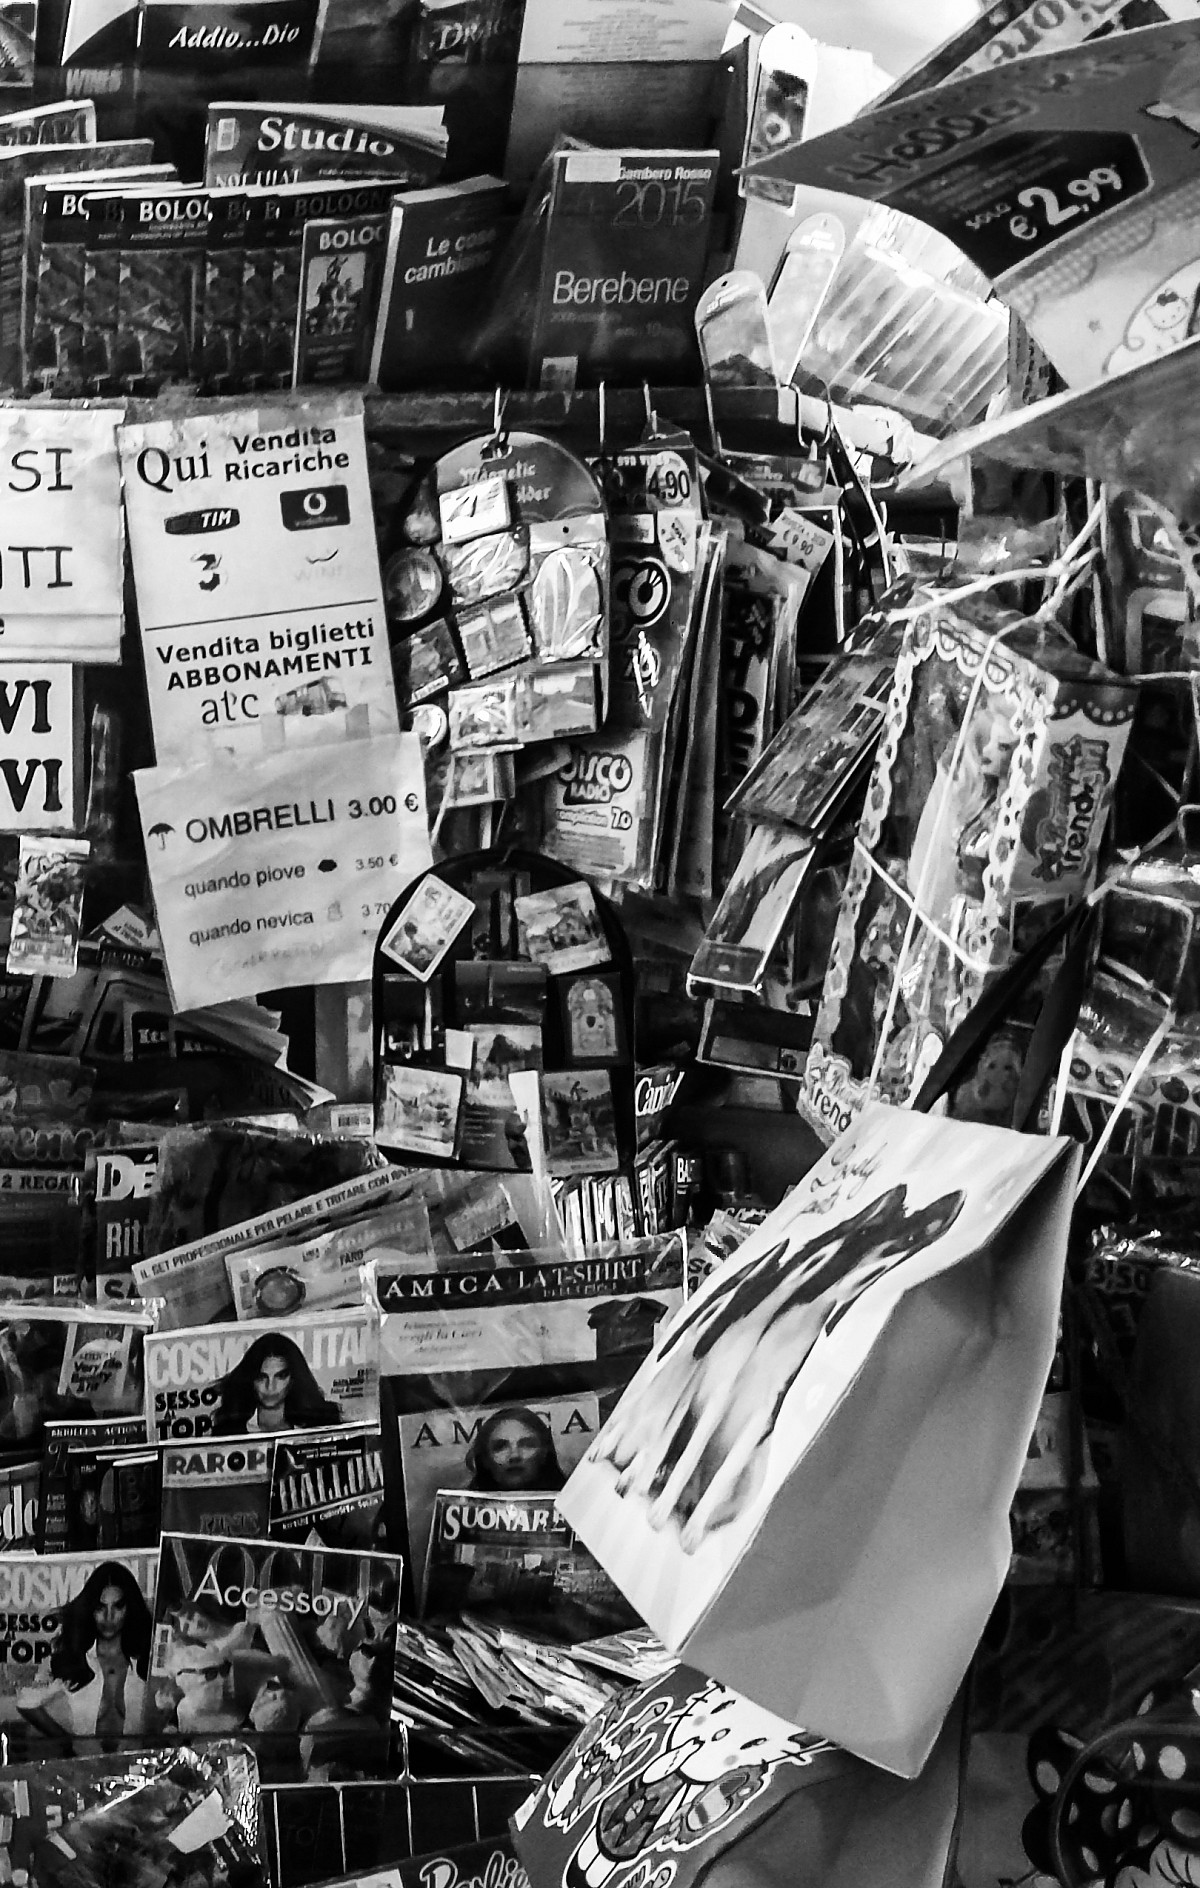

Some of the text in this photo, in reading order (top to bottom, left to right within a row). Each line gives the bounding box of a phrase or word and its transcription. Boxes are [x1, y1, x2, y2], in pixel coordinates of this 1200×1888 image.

[257, 116, 395, 156] Studio
[612, 180, 708, 227] 2015
[426, 236, 451, 257] Le
[553, 270, 690, 305] Berebene
[232, 426, 337, 454] Vendita
[136, 440, 213, 493] Qui
[224, 450, 350, 482] Ricariche
[200, 510, 232, 528] TIM
[157, 617, 375, 664] Vendita biglietti
[167, 646, 373, 690] ABBONAMENTI
[185, 792, 419, 843] OMBRELLI 3.00 €
[184, 871, 251, 898] quando
[255, 863, 306, 888] piove
[388, 853, 399, 868] €
[189, 918, 251, 947] quando
[256, 911, 314, 932] nevica
[1, 1173, 78, 1192] 2 REGA
[172, 1228, 252, 1271] PROFESSIONALE
[253, 1221, 275, 1237] PER
[275, 1204, 316, 1231] PELARE
[324, 1183, 367, 1210] TRITARE
[367, 1173, 390, 1191] CON
[384, 1273, 504, 1299] AMICA
[517, 1268, 547, 1290] LA
[155, 1386, 220, 1413] SESSO
[155, 1414, 213, 1441] TOP
[410, 1408, 594, 1449] AMA
[192, 1564, 367, 1631] Accessory
